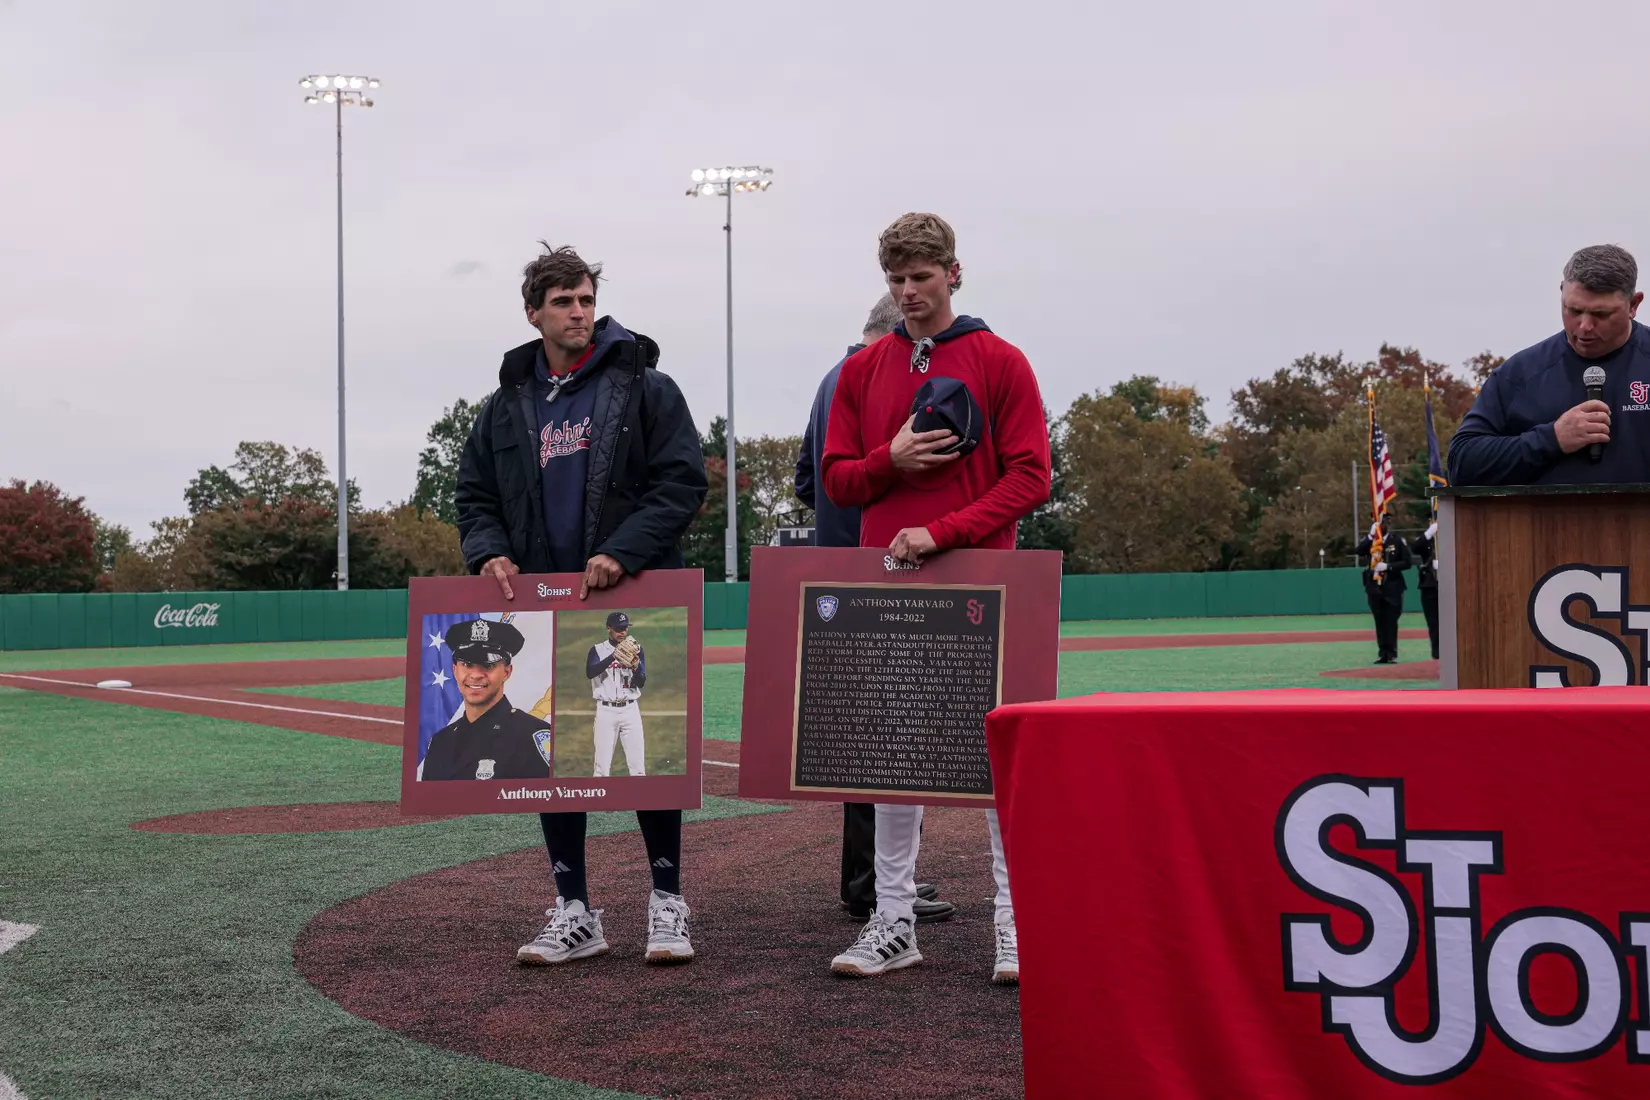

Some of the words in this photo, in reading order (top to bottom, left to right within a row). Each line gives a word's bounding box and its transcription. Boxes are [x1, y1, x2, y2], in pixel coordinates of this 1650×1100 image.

[540, 443, 582, 457] BASEBALL
[850, 599, 902, 608] ANTHONY
[905, 600, 954, 608] VARVARO
[154, 602, 221, 628] Coca-Cola
[880, 614, 924, 622] 1984-2022
[937, 763, 988, 771] TEAMMATES,
[497, 787, 553, 801] Anthony
[555, 786, 606, 798] Varvaro
